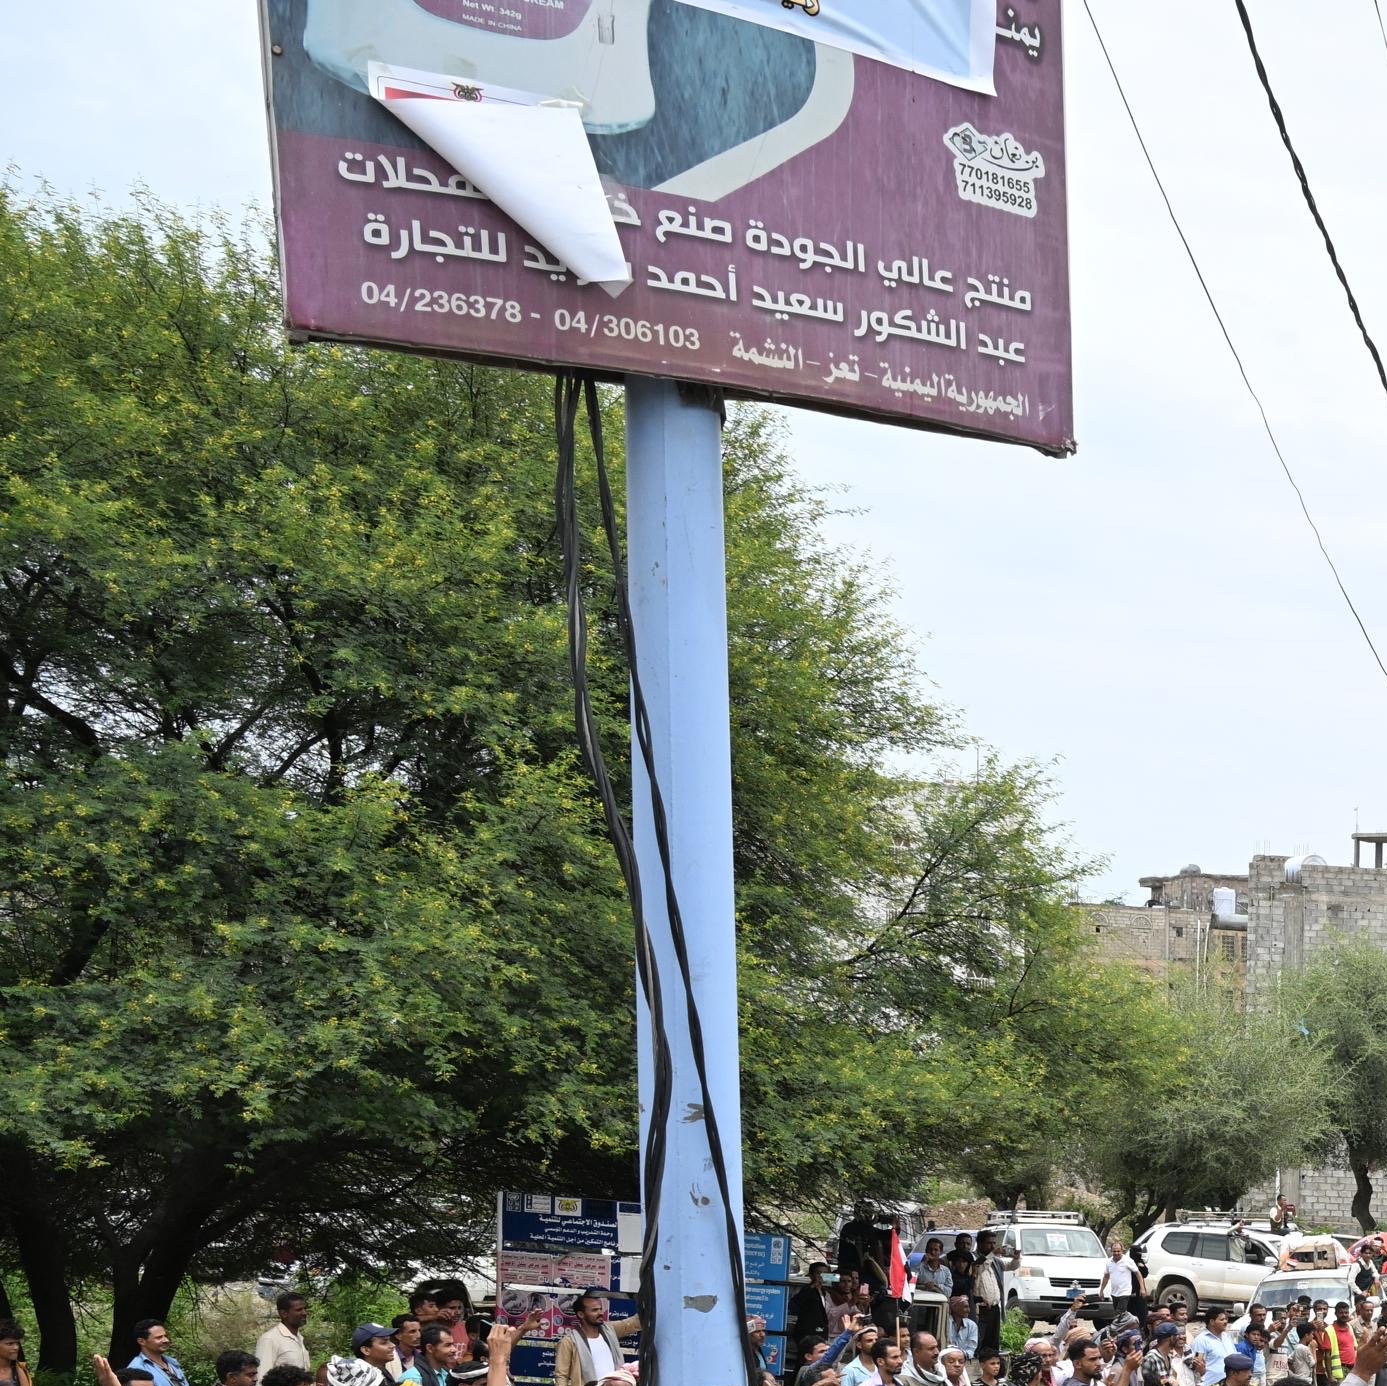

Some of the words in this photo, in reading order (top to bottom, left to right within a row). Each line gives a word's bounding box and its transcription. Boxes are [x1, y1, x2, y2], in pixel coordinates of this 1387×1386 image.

[461, 13, 485, 25] MADE
[497, 22, 522, 32] CHINA
[498, 6, 522, 20] 342g
[958, 162, 1031, 194] 770181655
[961, 179, 1033, 211] 711395928
[363, 212, 507, 264] للتجارة
[655, 205, 733, 243] صنع
[745, 219, 866, 273] الجودة
[647, 264, 738, 301] أحمد
[878, 255, 954, 292] عالي
[964, 273, 1032, 311] منتج
[360, 280, 522, 323] 04/236378
[553, 307, 700, 351] 04/306103
[752, 284, 844, 322] سعيد
[854, 308, 967, 350] الشكور
[729, 330, 803, 371] النشمة
[977, 332, 1026, 366] عبد
[822, 353, 860, 384] تعز
[878, 359, 946, 403] اليمنية
[946, 373, 1030, 422] الجمهورية
[561, 1217, 593, 1227] الاجتماعي
